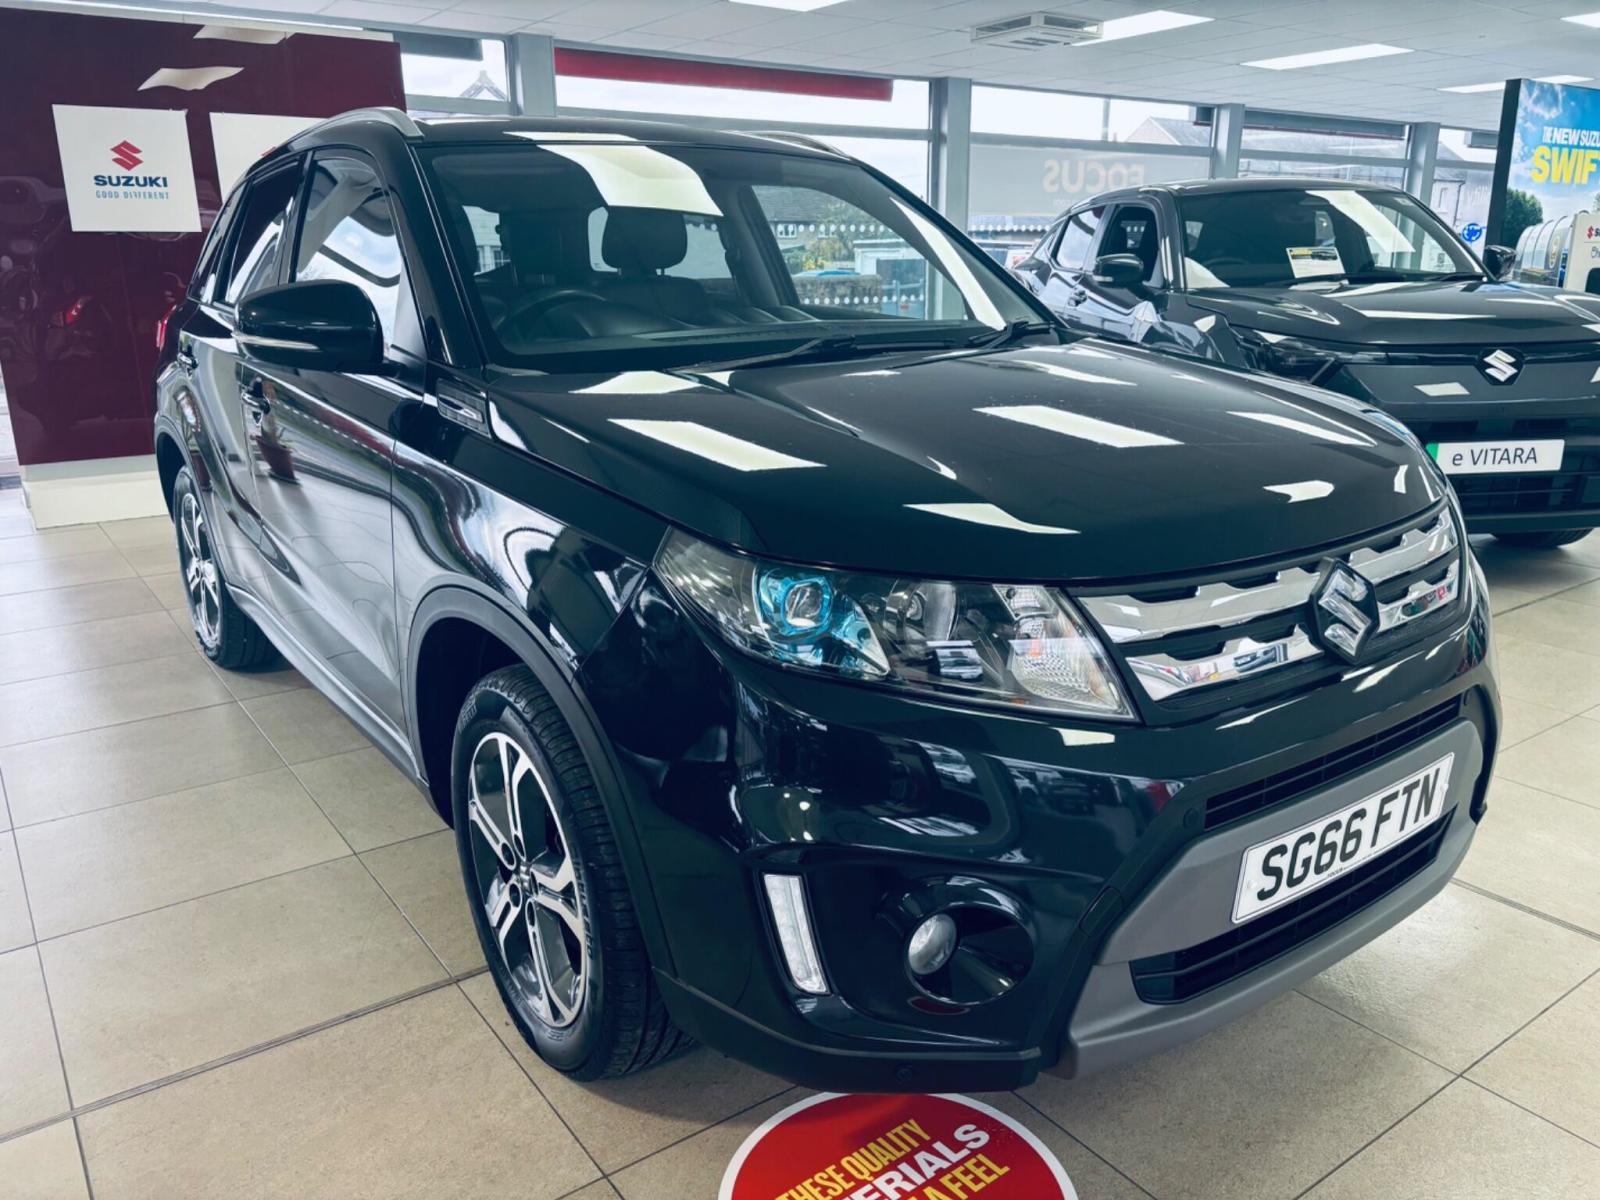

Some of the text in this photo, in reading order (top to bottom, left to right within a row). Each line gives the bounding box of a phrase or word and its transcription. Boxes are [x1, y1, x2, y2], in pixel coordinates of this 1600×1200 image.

[1552, 127, 1581, 146] NEW
[93, 174, 168, 188] SUZUKI
[1531, 145, 1600, 185] SWIF
[95, 190, 169, 200] GOOD DIFFERENT
[1452, 447, 1538, 466] e VITARA
[1257, 767, 1441, 901] SG66 FTN
[841, 1117, 931, 1182] QUALITY
[842, 1124, 990, 1200] ERIALS
[939, 1153, 1010, 1200] FEEL
